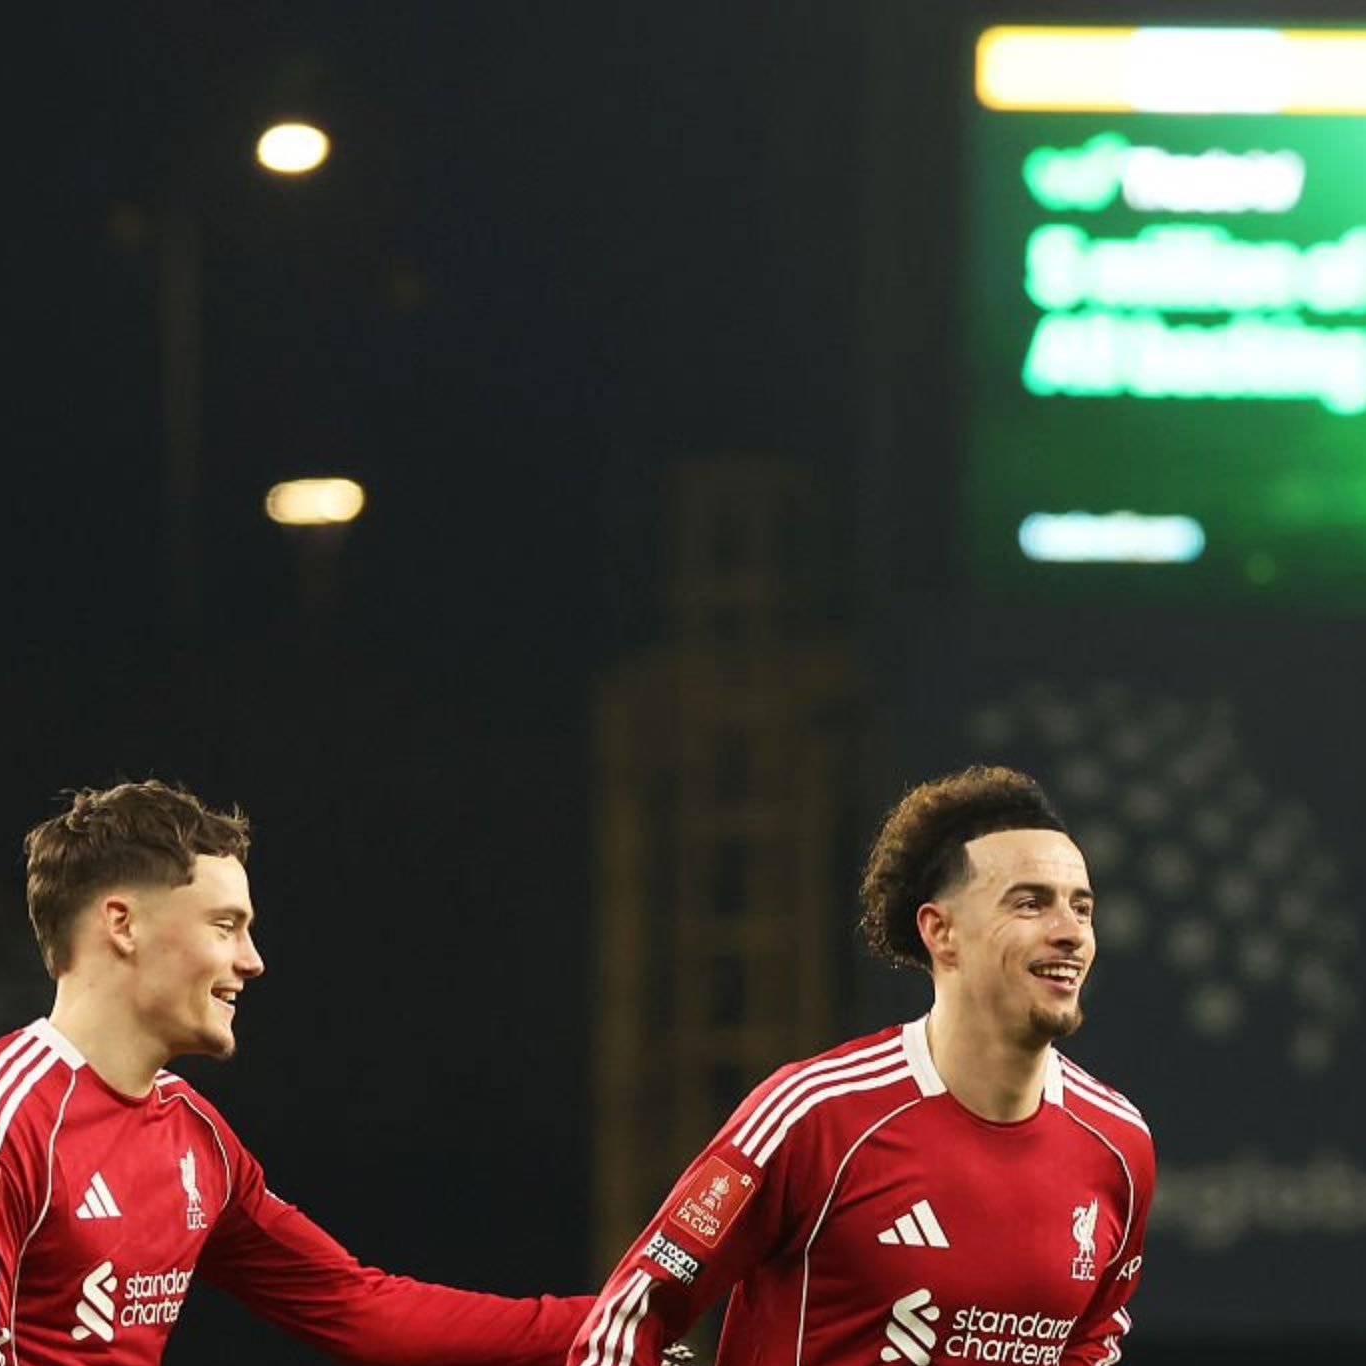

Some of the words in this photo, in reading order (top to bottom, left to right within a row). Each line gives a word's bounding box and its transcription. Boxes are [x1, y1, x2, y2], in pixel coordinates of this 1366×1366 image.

[690, 1217, 716, 1237] CUP
[663, 1240, 699, 1273] room
[952, 1305, 1078, 1339] standard
